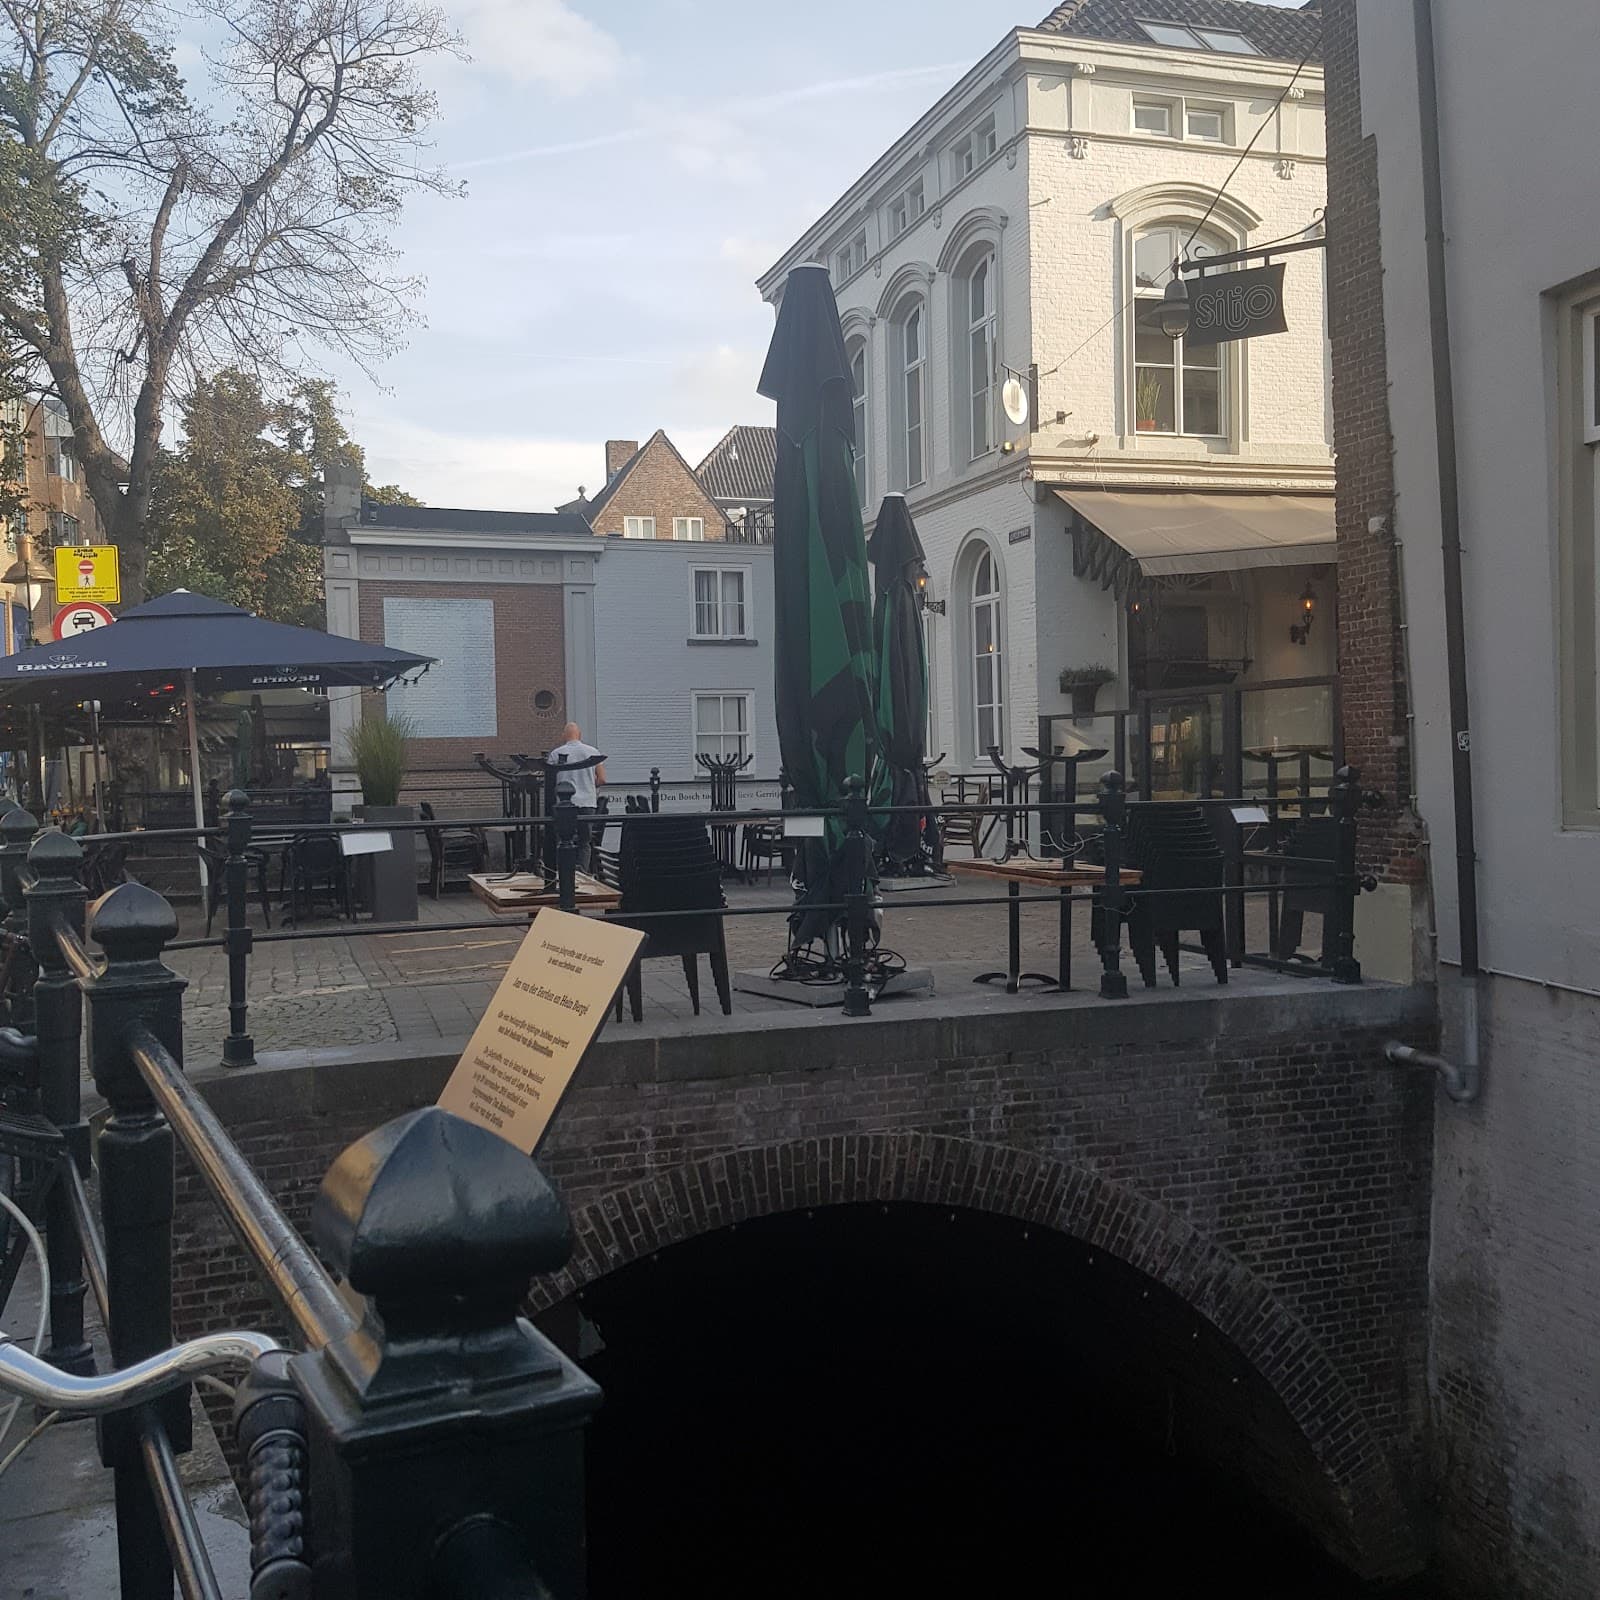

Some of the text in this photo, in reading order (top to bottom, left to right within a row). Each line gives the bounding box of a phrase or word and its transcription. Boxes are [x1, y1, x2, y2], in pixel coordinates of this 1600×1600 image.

[16, 660, 108, 671] Bavaria
[660, 793, 676, 801] Den
[678, 792, 700, 801] Bosch
[521, 982, 530, 992] van
[528, 984, 538, 995] der
